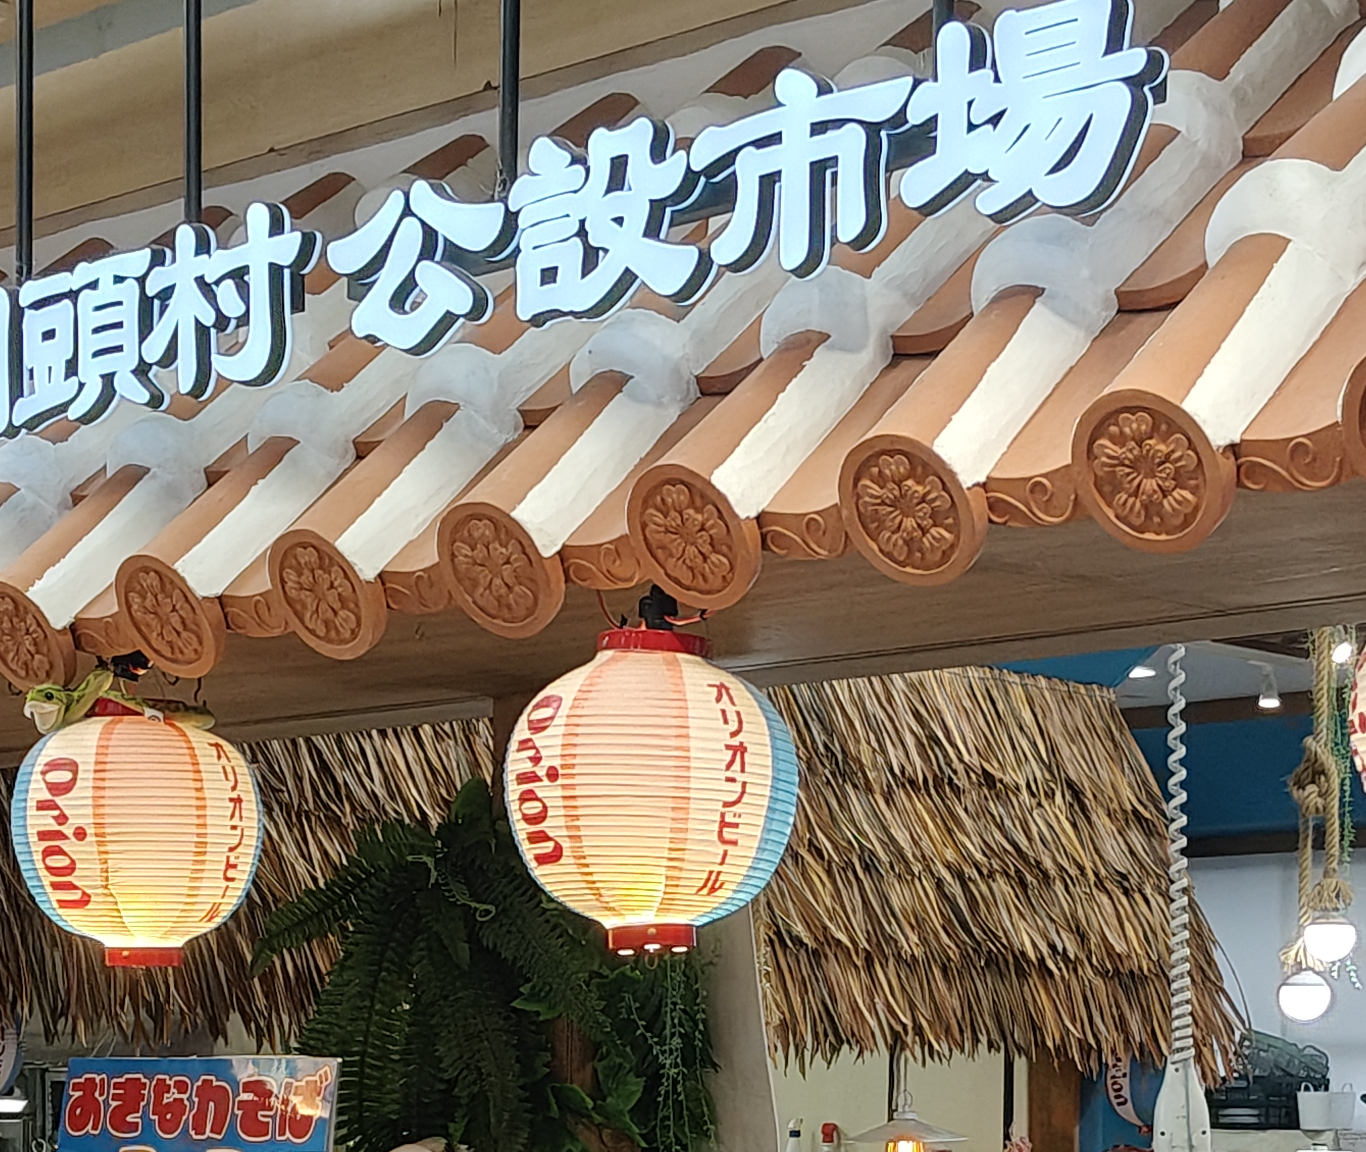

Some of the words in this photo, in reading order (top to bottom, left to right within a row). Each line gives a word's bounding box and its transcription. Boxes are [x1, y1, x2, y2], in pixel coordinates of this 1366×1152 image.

[330, 0, 1157, 354] 公設市場
[36, 756, 93, 912] Orion
[198, 740, 246, 925] オリオンビール
[515, 694, 565, 868] Orion
[694, 681, 750, 898] オリオンビール
[65, 1064, 333, 1143] おきなわそば
